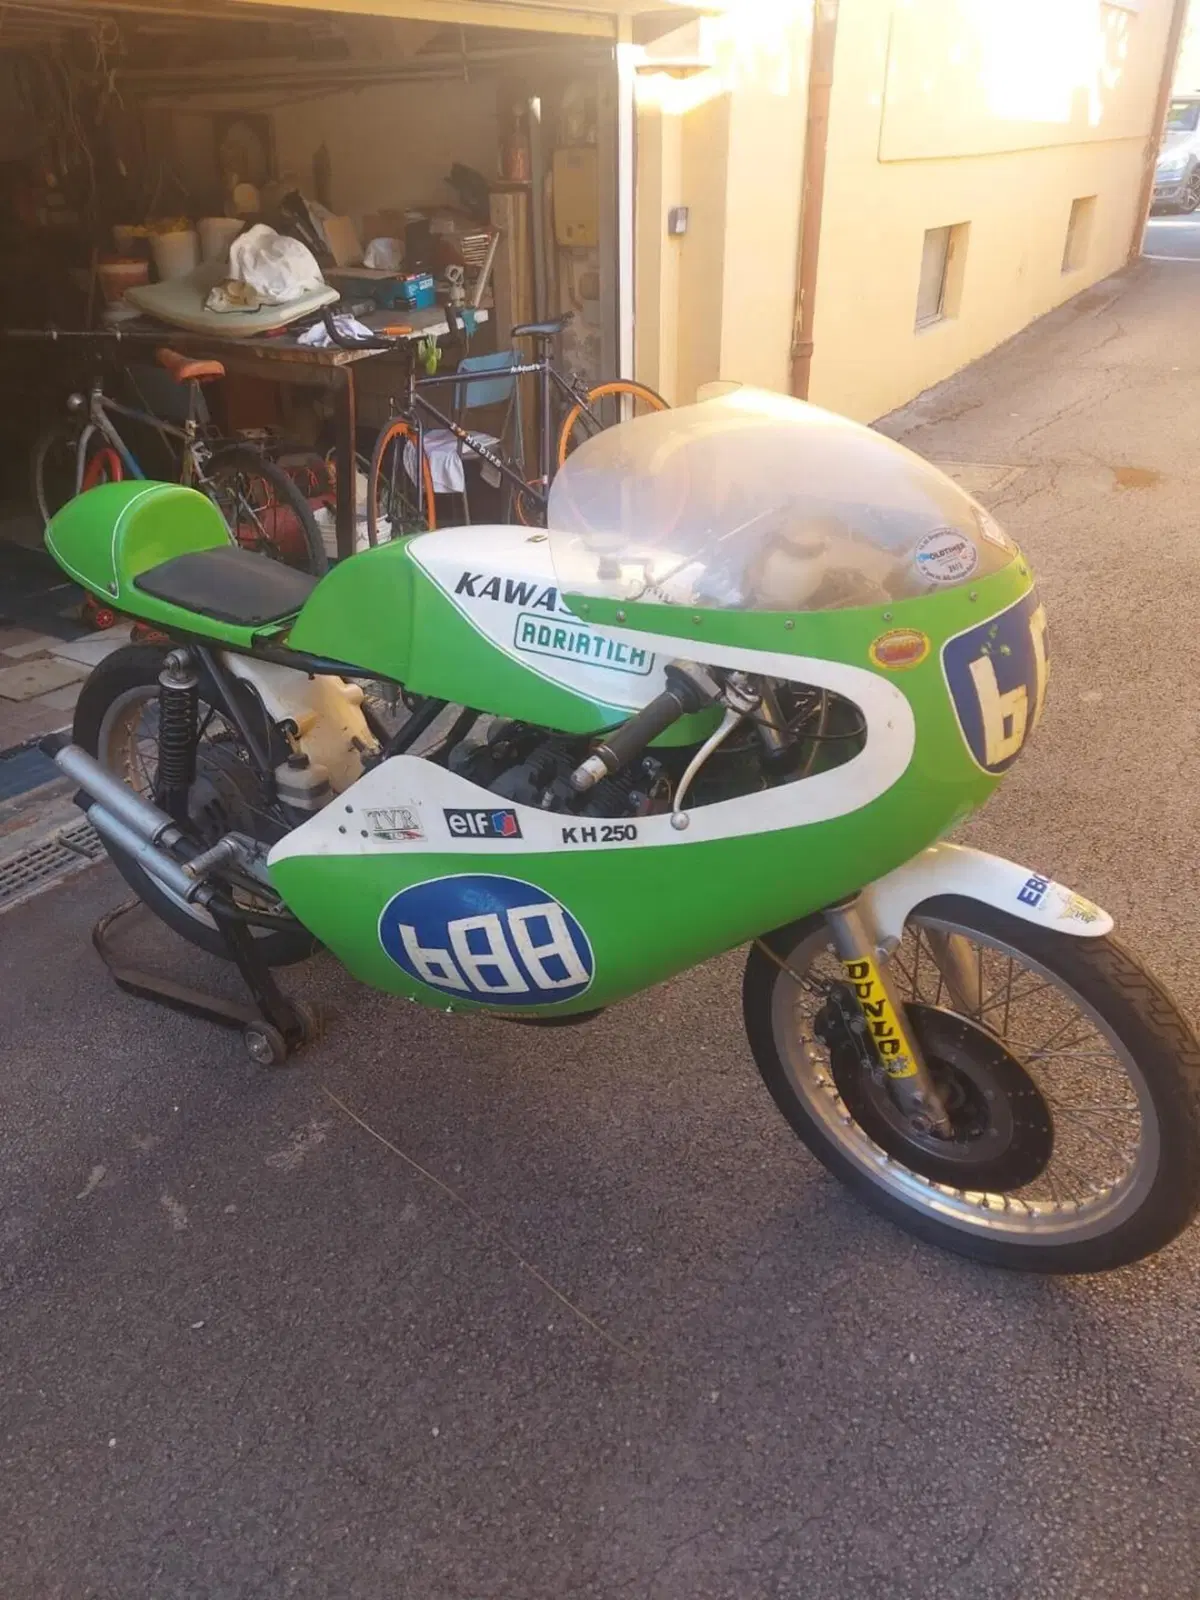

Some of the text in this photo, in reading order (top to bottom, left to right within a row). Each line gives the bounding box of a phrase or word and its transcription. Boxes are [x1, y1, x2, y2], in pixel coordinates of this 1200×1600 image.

[454, 571, 577, 616] KAWA
[521, 622, 646, 667] ADRIATICH
[449, 812, 489, 835] elf
[399, 902, 590, 993] 688
[846, 961, 909, 1074] DUNLO
